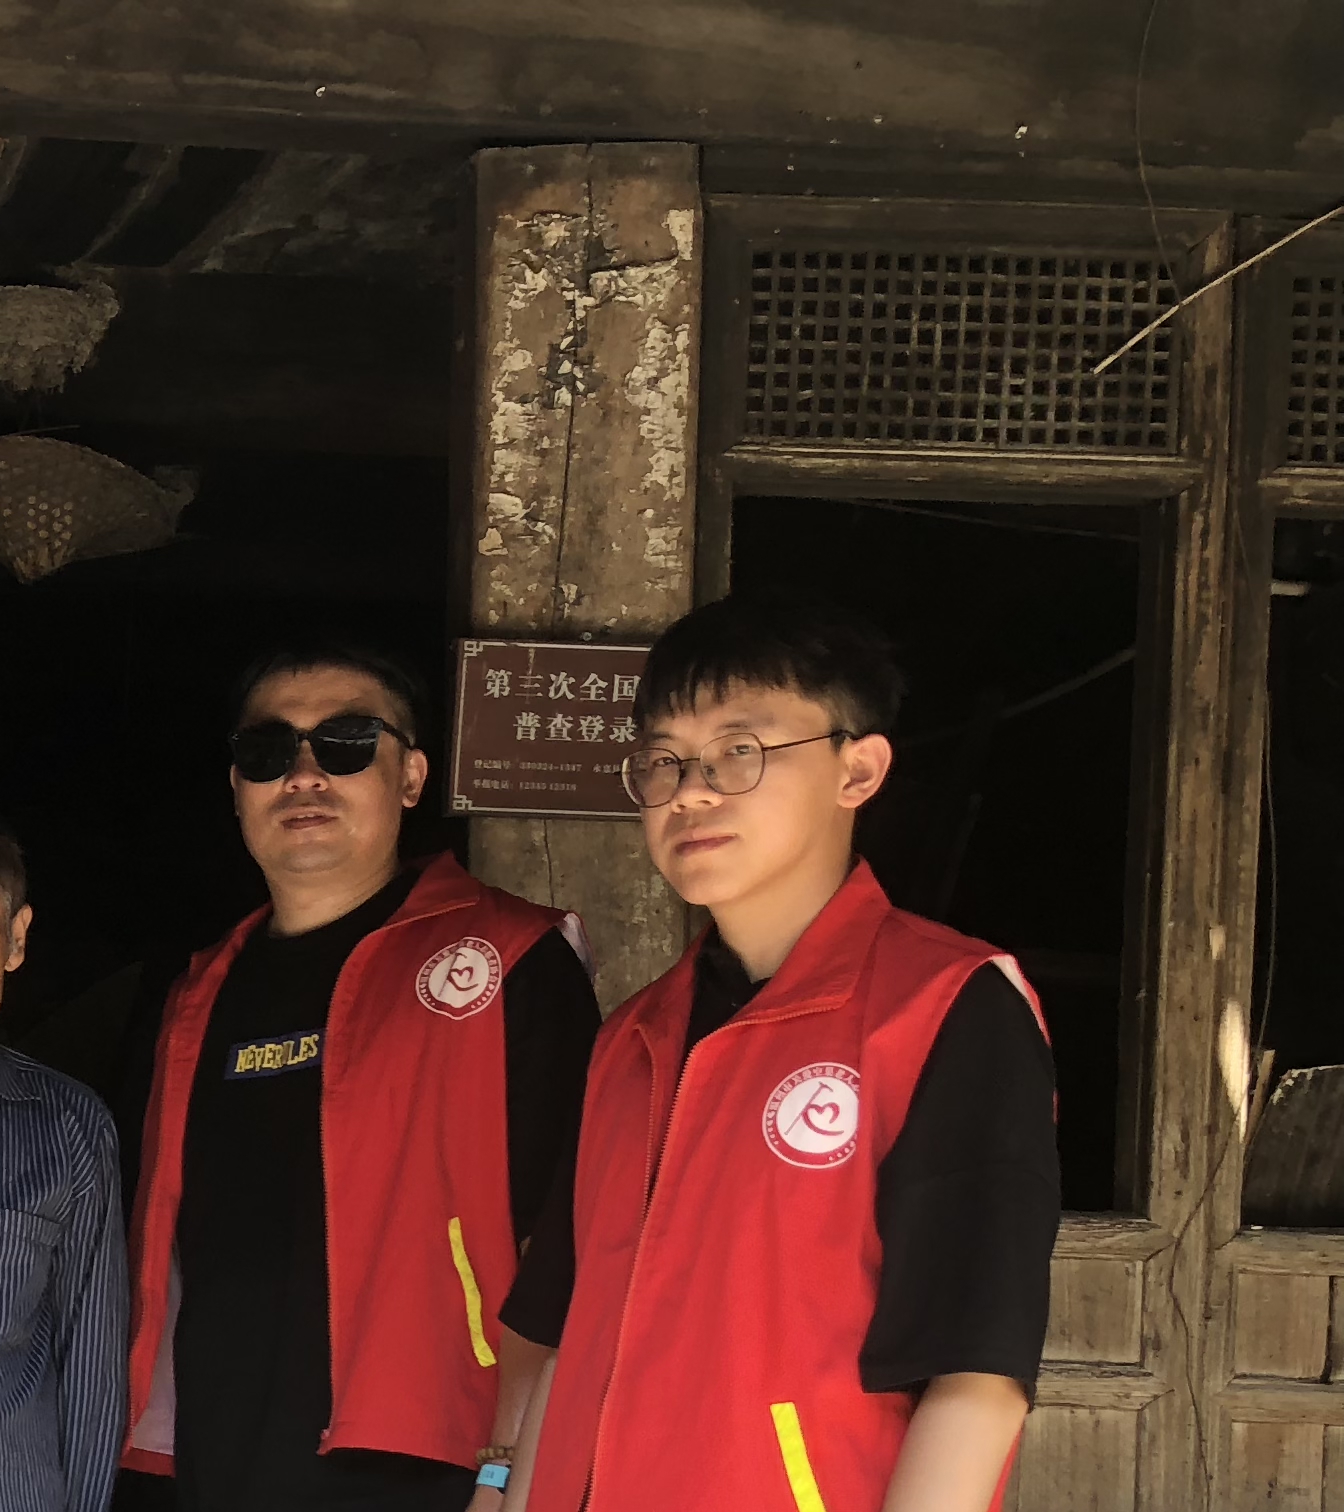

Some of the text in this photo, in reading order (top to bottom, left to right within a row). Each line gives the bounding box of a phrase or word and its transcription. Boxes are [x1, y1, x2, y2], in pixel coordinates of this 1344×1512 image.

[483, 668, 641, 702] 第三次全国
[513, 712, 638, 743] 普查登录
